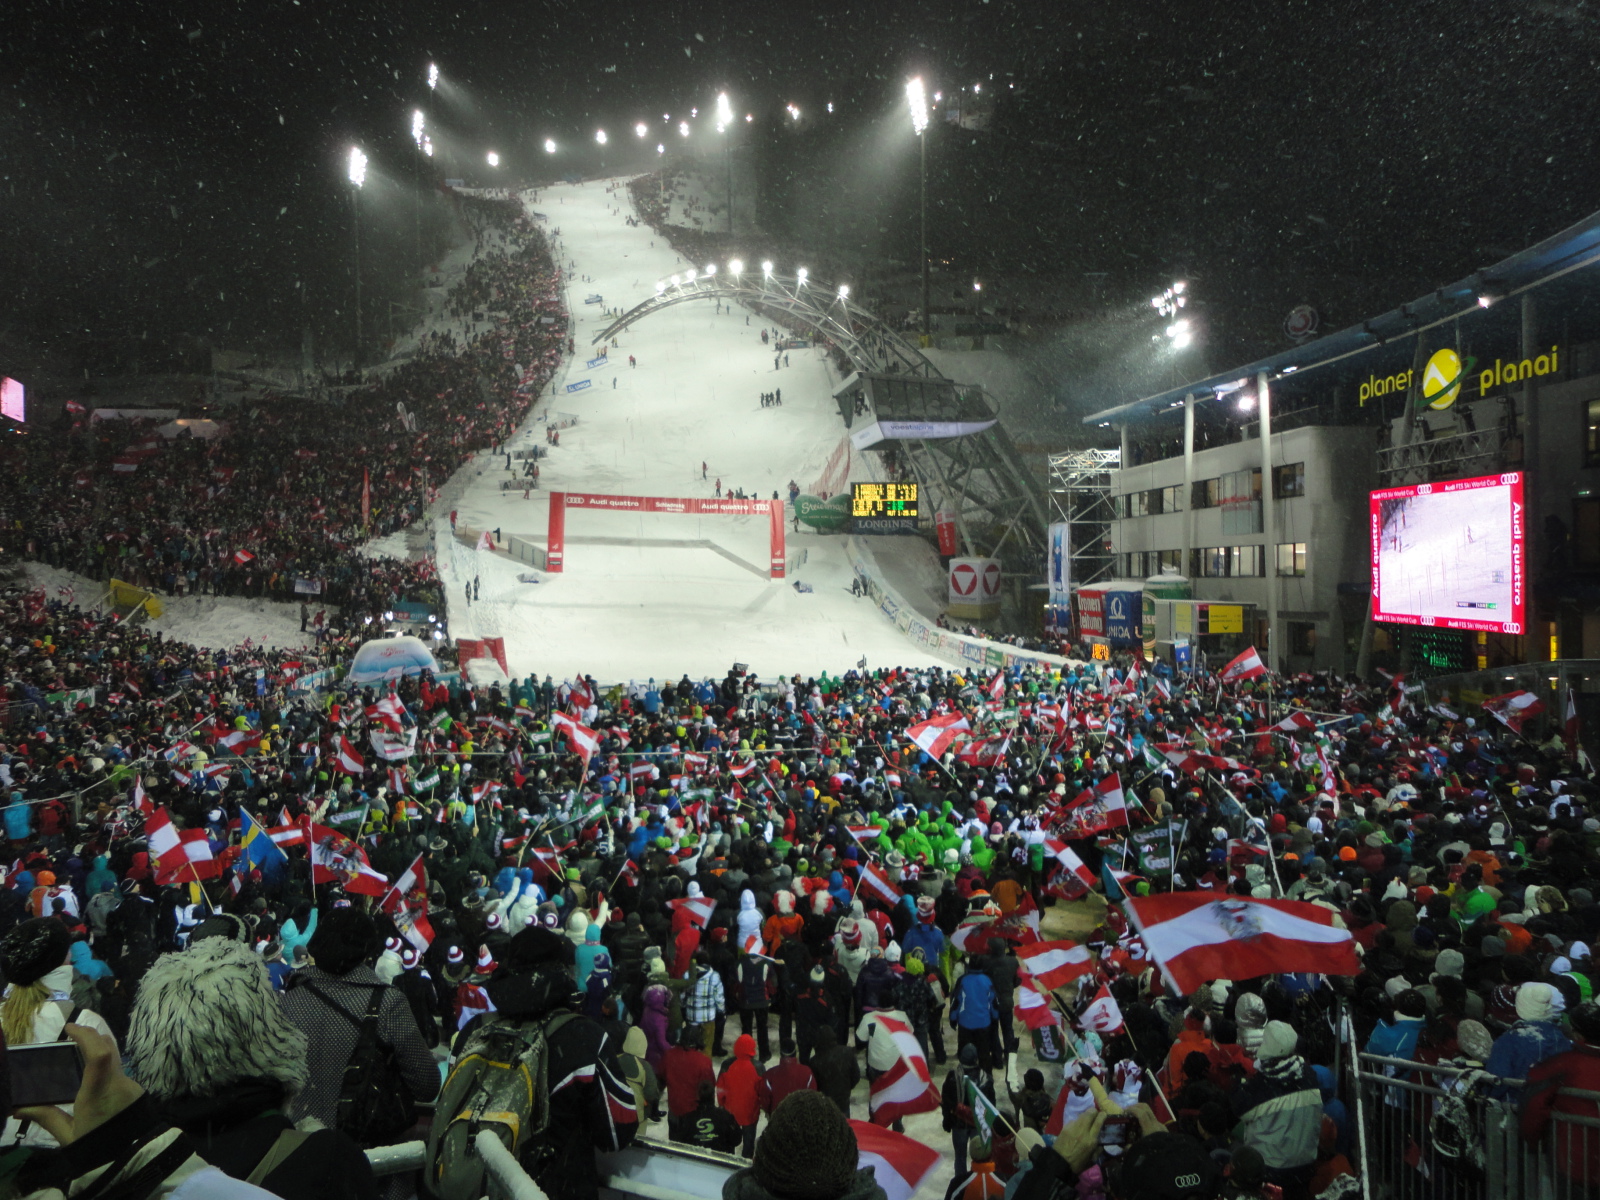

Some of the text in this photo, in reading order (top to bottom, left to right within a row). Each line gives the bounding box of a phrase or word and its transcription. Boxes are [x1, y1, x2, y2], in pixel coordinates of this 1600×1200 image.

[1359, 345, 1558, 407] planet planai
[609, 499, 639, 507] quattro
[720, 503, 749, 511] quattro
[858, 520, 913, 529] LONGINES
[1372, 514, 1380, 564] quattro
[1512, 502, 1522, 605] Audi quattro
[1107, 625, 1131, 639] UNIQA
[599, 841, 608, 855] 5
[1039, 1025, 1060, 1059] Gösse
